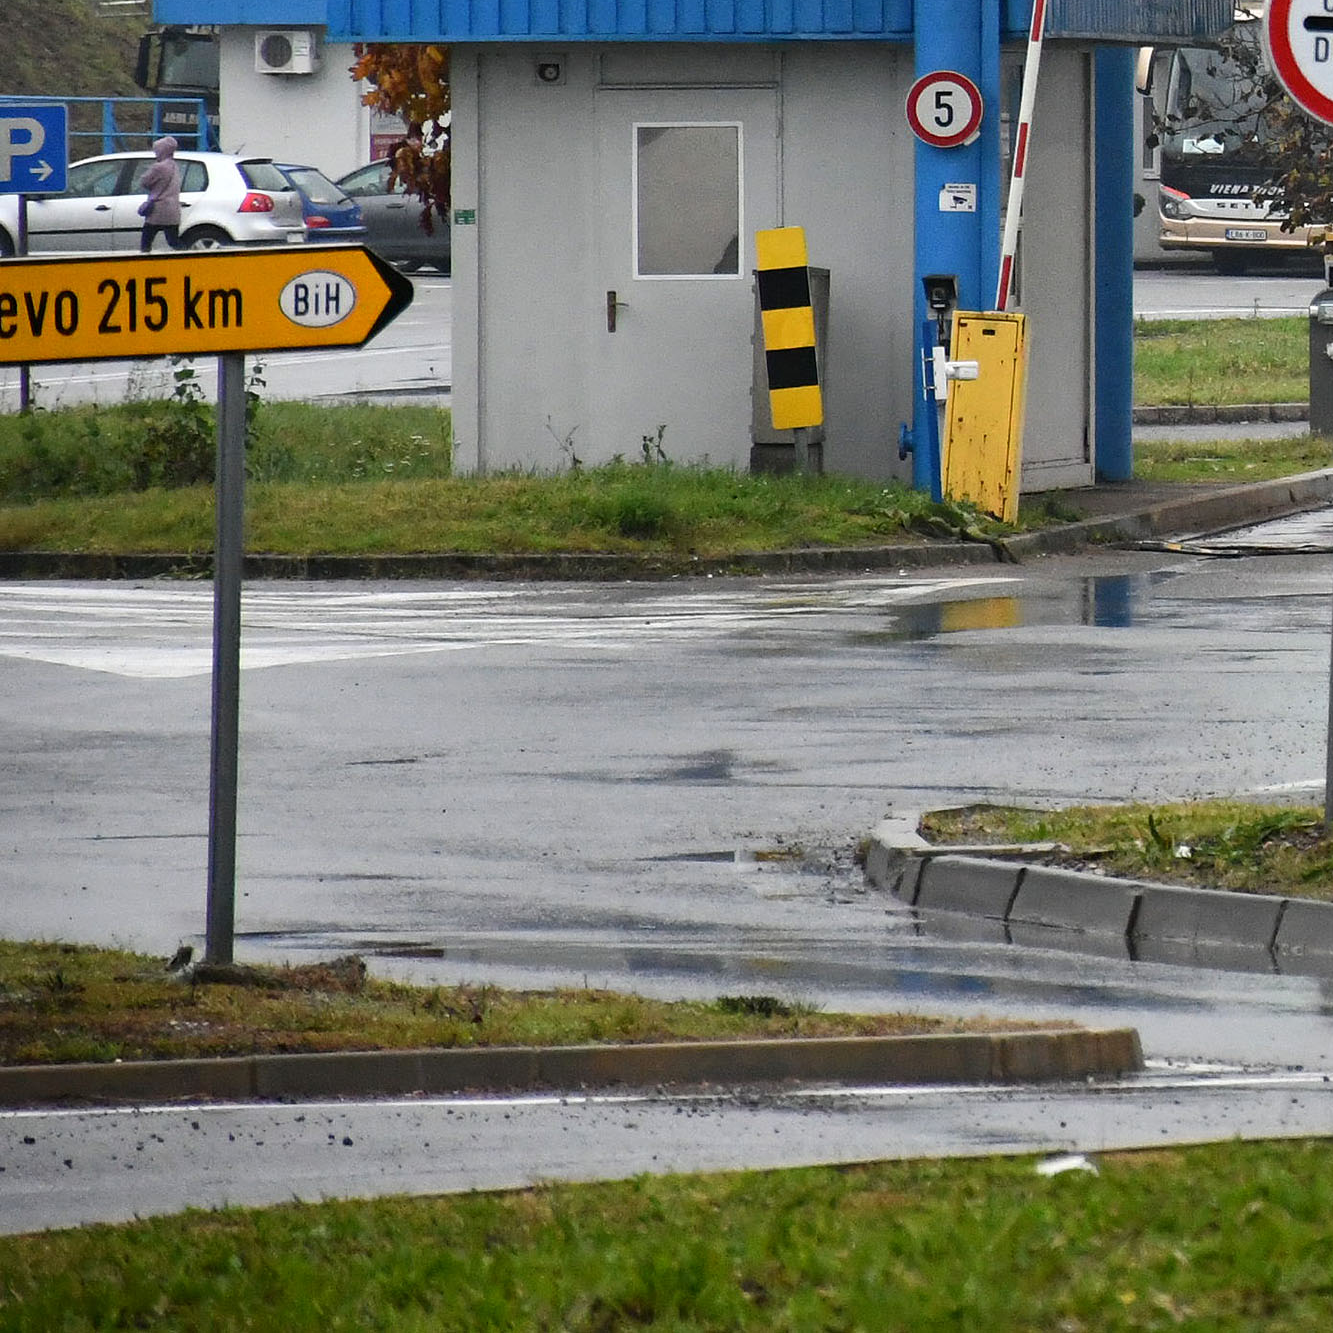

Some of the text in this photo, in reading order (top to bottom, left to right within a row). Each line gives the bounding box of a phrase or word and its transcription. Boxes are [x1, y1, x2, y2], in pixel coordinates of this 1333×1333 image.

[934, 91, 953, 127] 5
[0, 117, 45, 182] P
[0, 276, 340, 339] evo 215 km BiH
